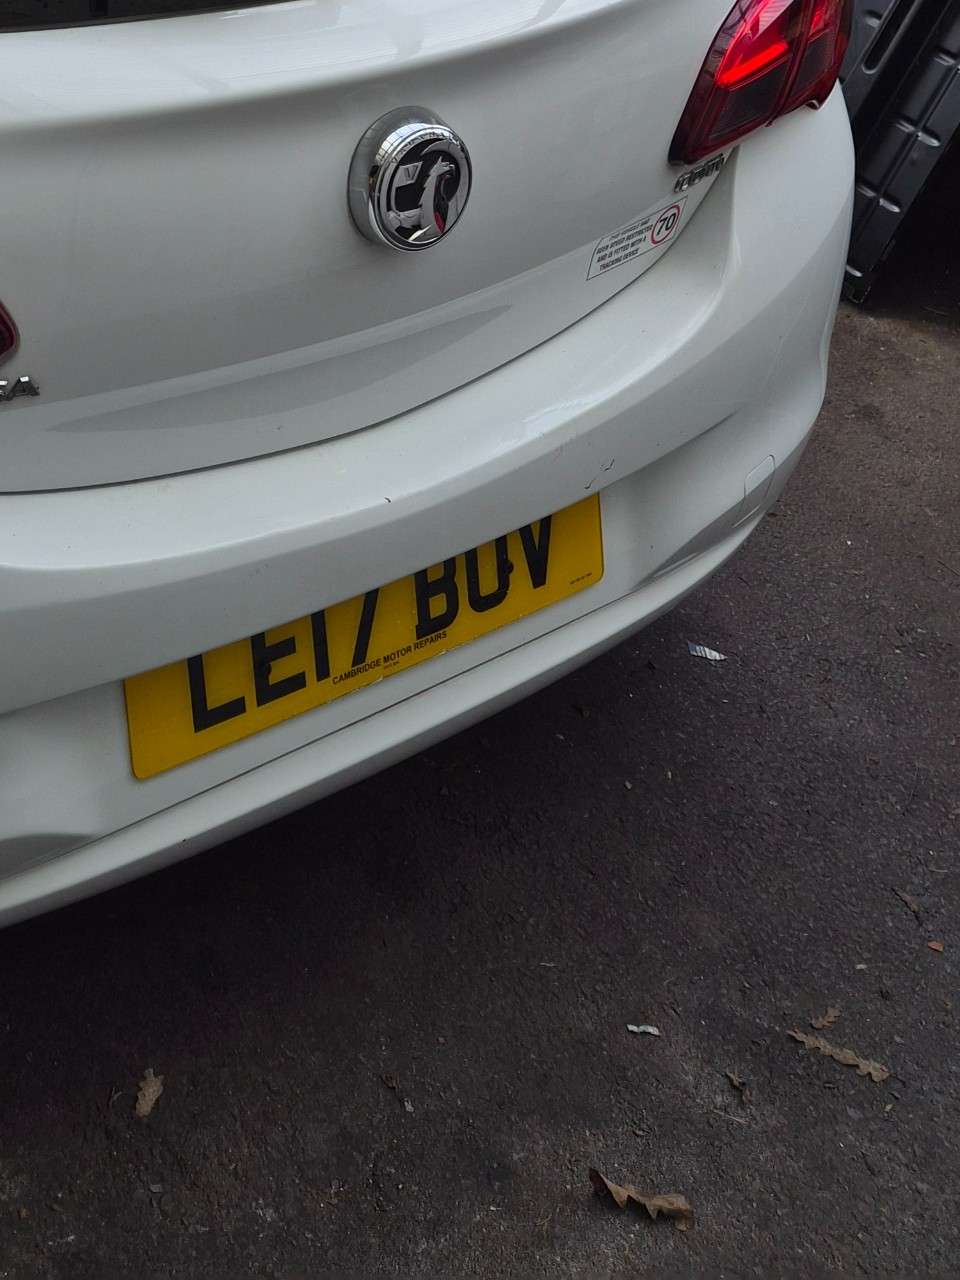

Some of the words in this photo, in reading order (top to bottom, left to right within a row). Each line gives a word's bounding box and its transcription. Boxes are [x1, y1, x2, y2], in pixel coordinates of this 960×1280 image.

[656, 212, 677, 235] 70
[613, 243, 630, 257] FITTED
[332, 657, 382, 685] CAMBRIDGE
[382, 645, 412, 664] MOTOR
[413, 630, 448, 651] REPAIRS
